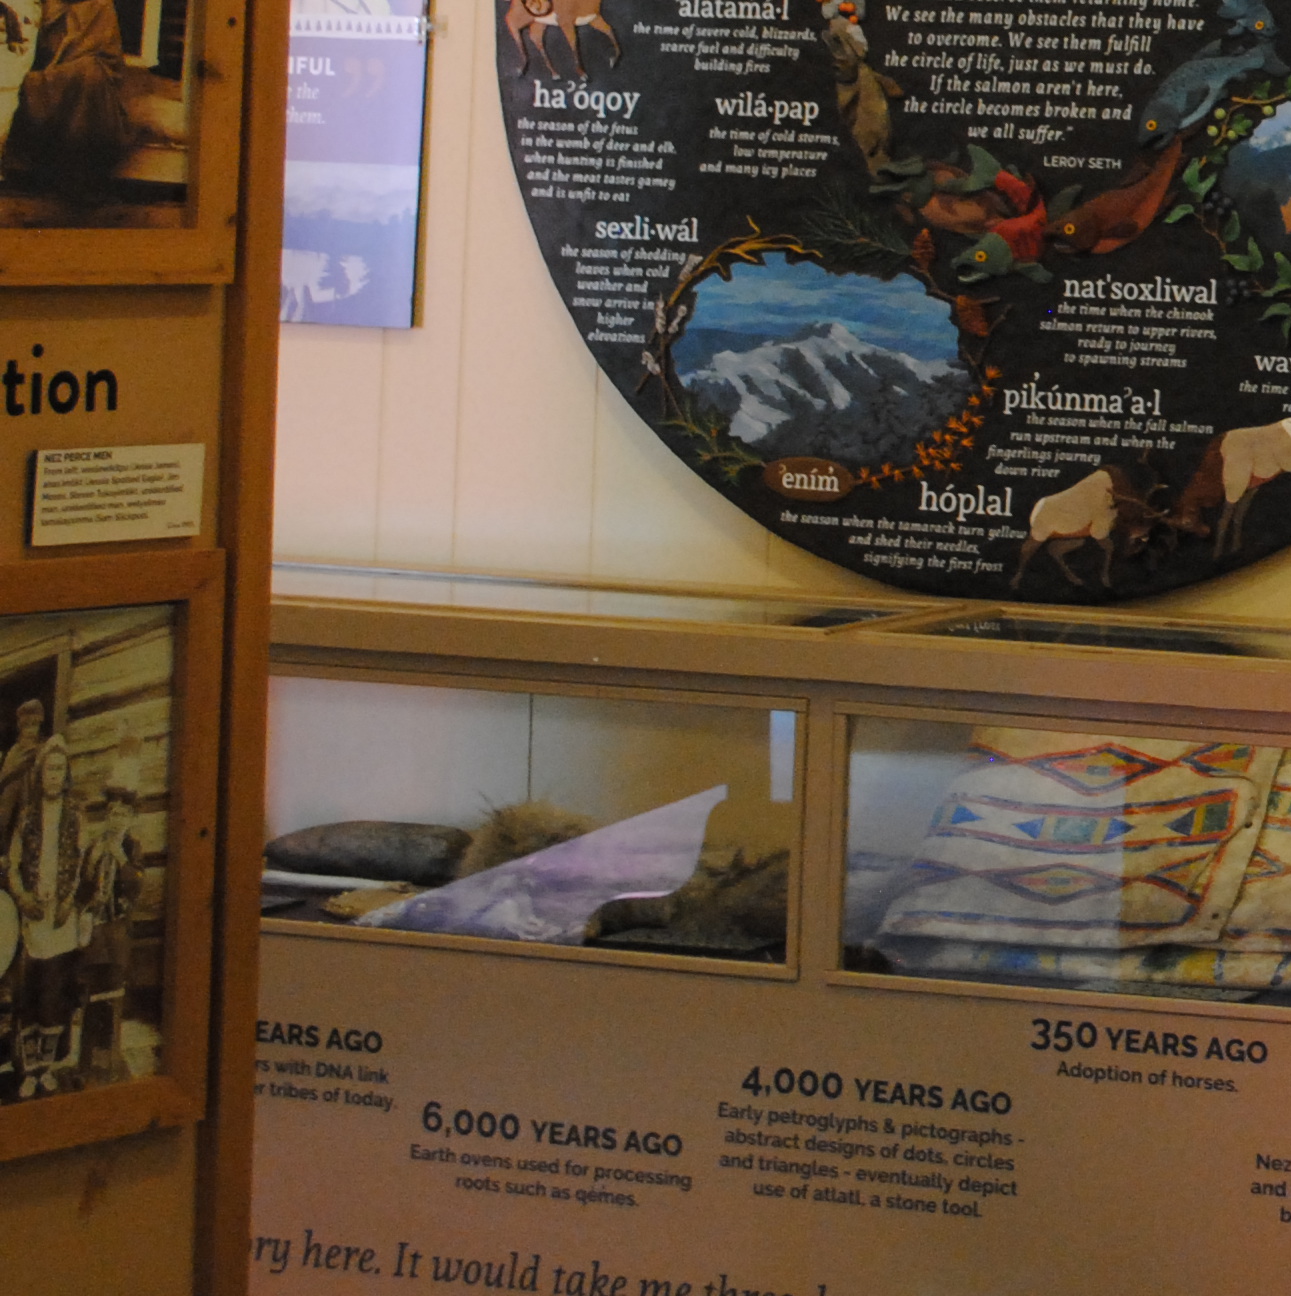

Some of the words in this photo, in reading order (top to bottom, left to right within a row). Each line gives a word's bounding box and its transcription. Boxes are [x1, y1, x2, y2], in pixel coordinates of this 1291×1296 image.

[1042, 154, 1086, 169] LEROY
[1087, 156, 1122, 170] SETH
[2, 343, 118, 417] tion
[918, 480, 1013, 522] hóplal
[255, 1020, 321, 1048] EARS
[325, 1027, 384, 1054] AGO
[1030, 1017, 1098, 1053] 350
[1105, 1026, 1199, 1059] YEARS
[1204, 1036, 1269, 1065] AGO
[741, 1065, 844, 1100] 4,000
[854, 1077, 944, 1110] YEARS
[950, 1087, 1013, 1116] AGO
[1055, 1060, 1143, 1085] Adoption
[1147, 1069, 1168, 1086] of
[1171, 1070, 1239, 1093] horses.
[421, 1100, 521, 1141] 6,000
[530, 1119, 618, 1151] YEARS
[623, 1129, 684, 1158] AGO
[302, 1229, 382, 1277] here.
[393, 1241, 421, 1280] It
[430, 1251, 541, 1293] would
[552, 1260, 628, 1296] take
